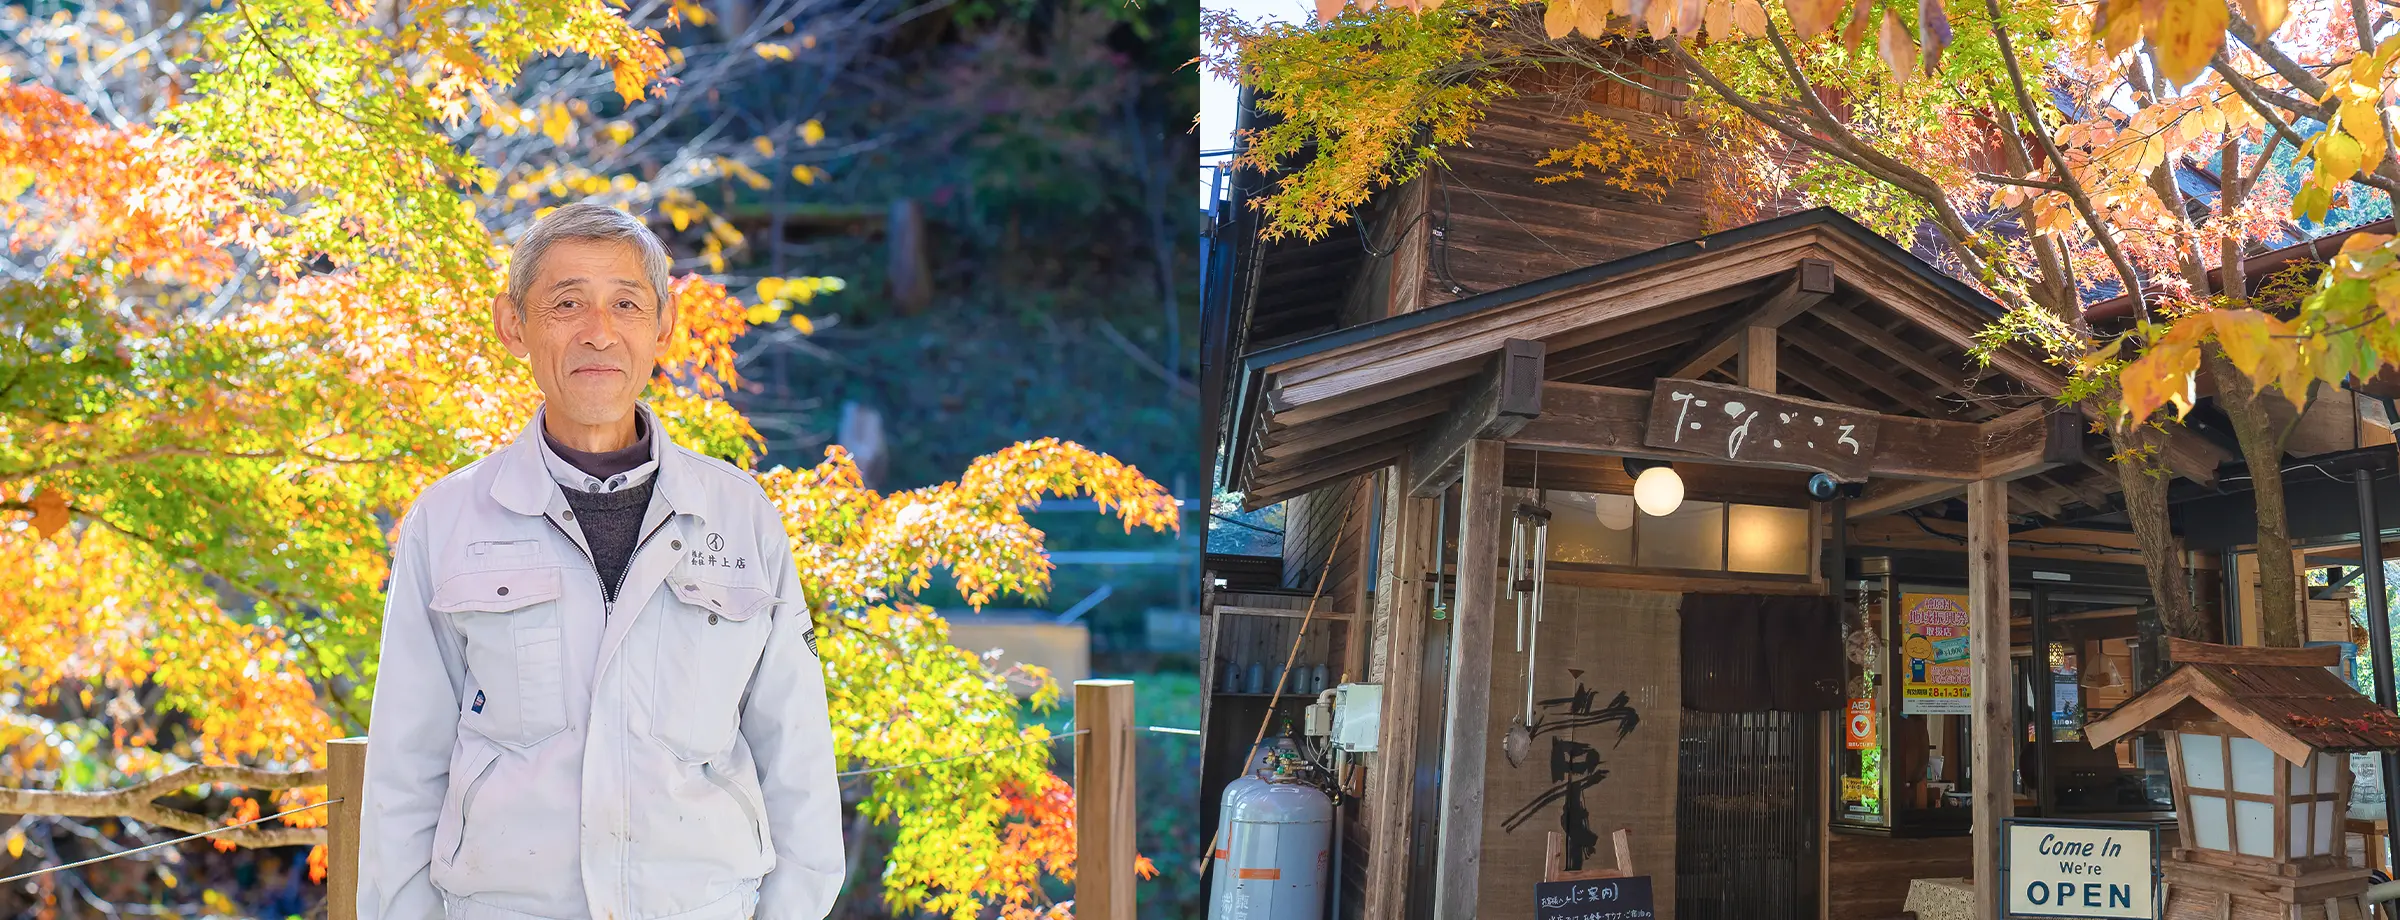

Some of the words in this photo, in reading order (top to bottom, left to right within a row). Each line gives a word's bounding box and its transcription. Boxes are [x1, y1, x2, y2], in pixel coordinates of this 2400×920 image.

[1671, 390, 1860, 459] たなごころ
[1926, 626, 1952, 637] 取扱店
[1851, 701, 1871, 710] AED
[2038, 833, 2095, 857] Come
[2101, 836, 2122, 858] In
[2059, 860, 2102, 876] We're
[2026, 880, 2131, 909] OPEN
